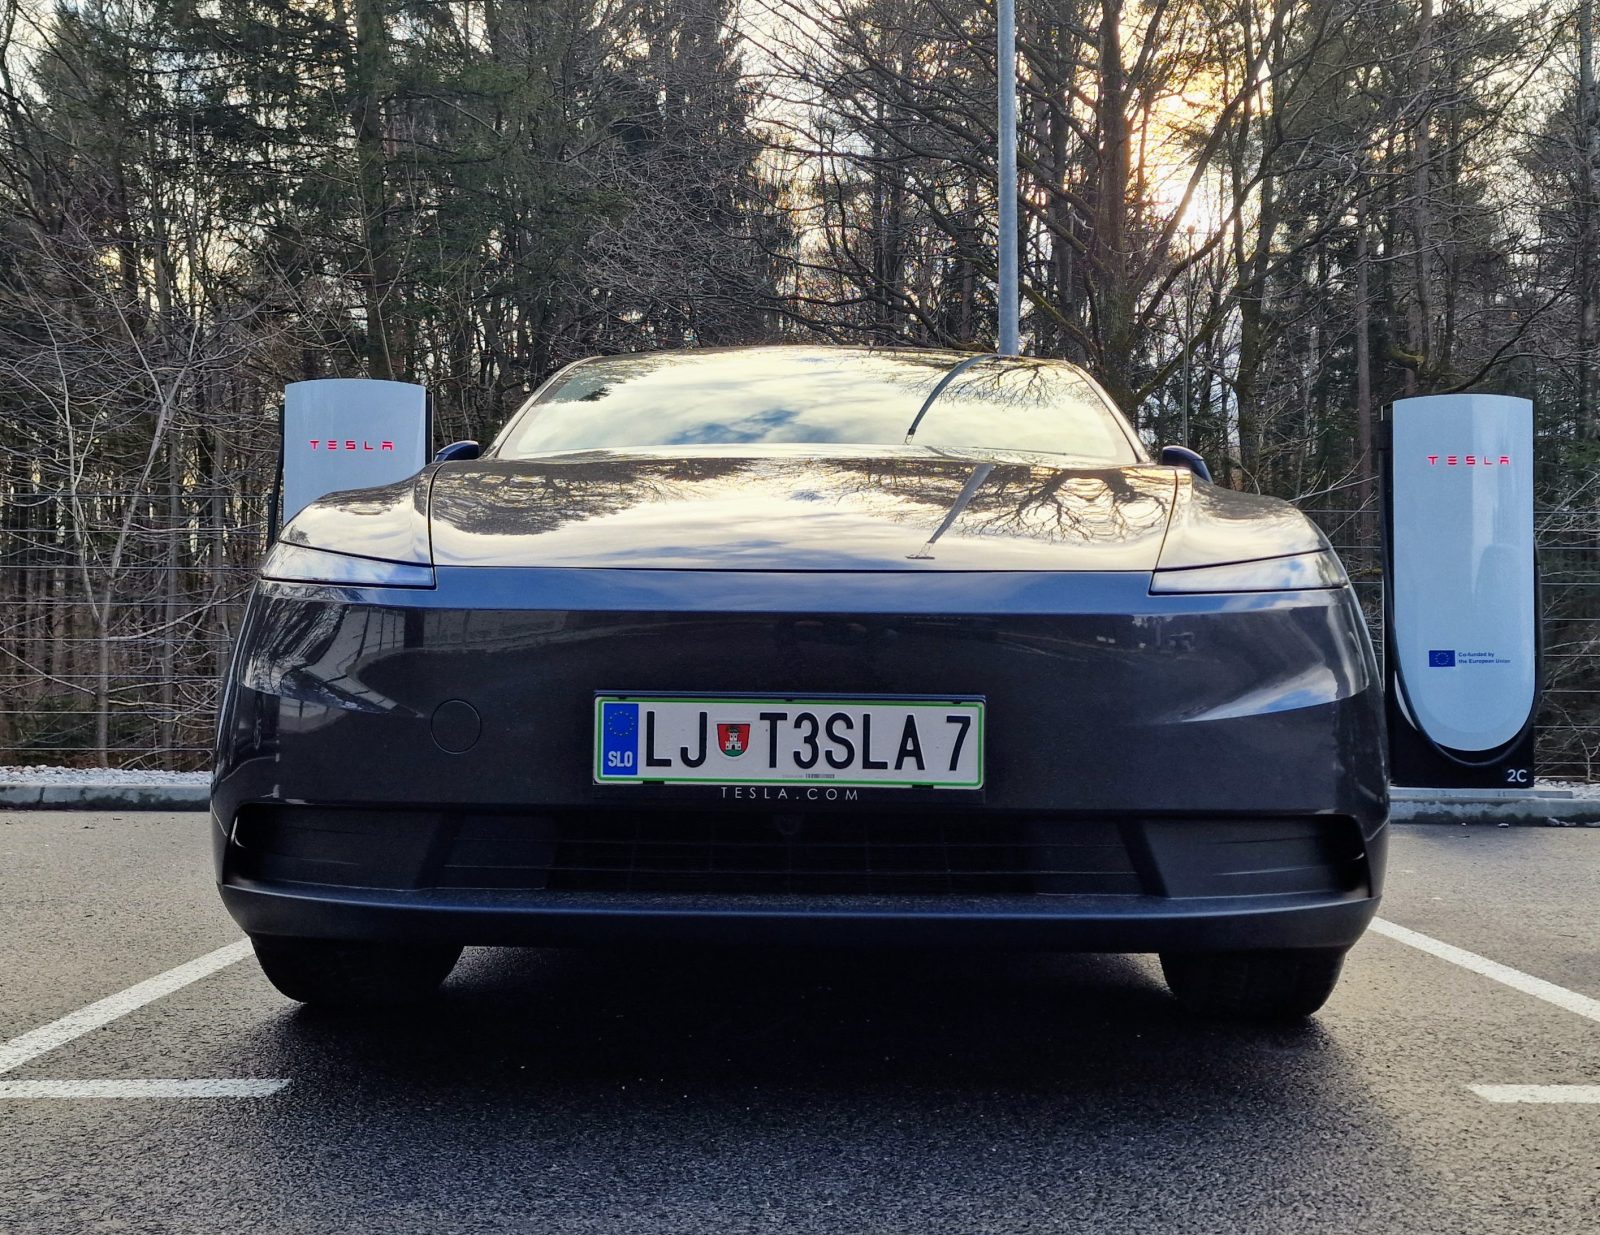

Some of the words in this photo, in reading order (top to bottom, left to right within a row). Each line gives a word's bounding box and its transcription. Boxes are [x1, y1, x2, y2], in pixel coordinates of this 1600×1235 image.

[310, 440, 393, 450] TESLA
[1427, 456, 1509, 465] TESLA
[646, 711, 707, 768] LJ
[760, 712, 925, 770] T3SLA
[946, 715, 971, 771] 7
[607, 751, 633, 768] SLO
[1507, 769, 1527, 782] 2C
[721, 787, 858, 800] TESLA.COM
